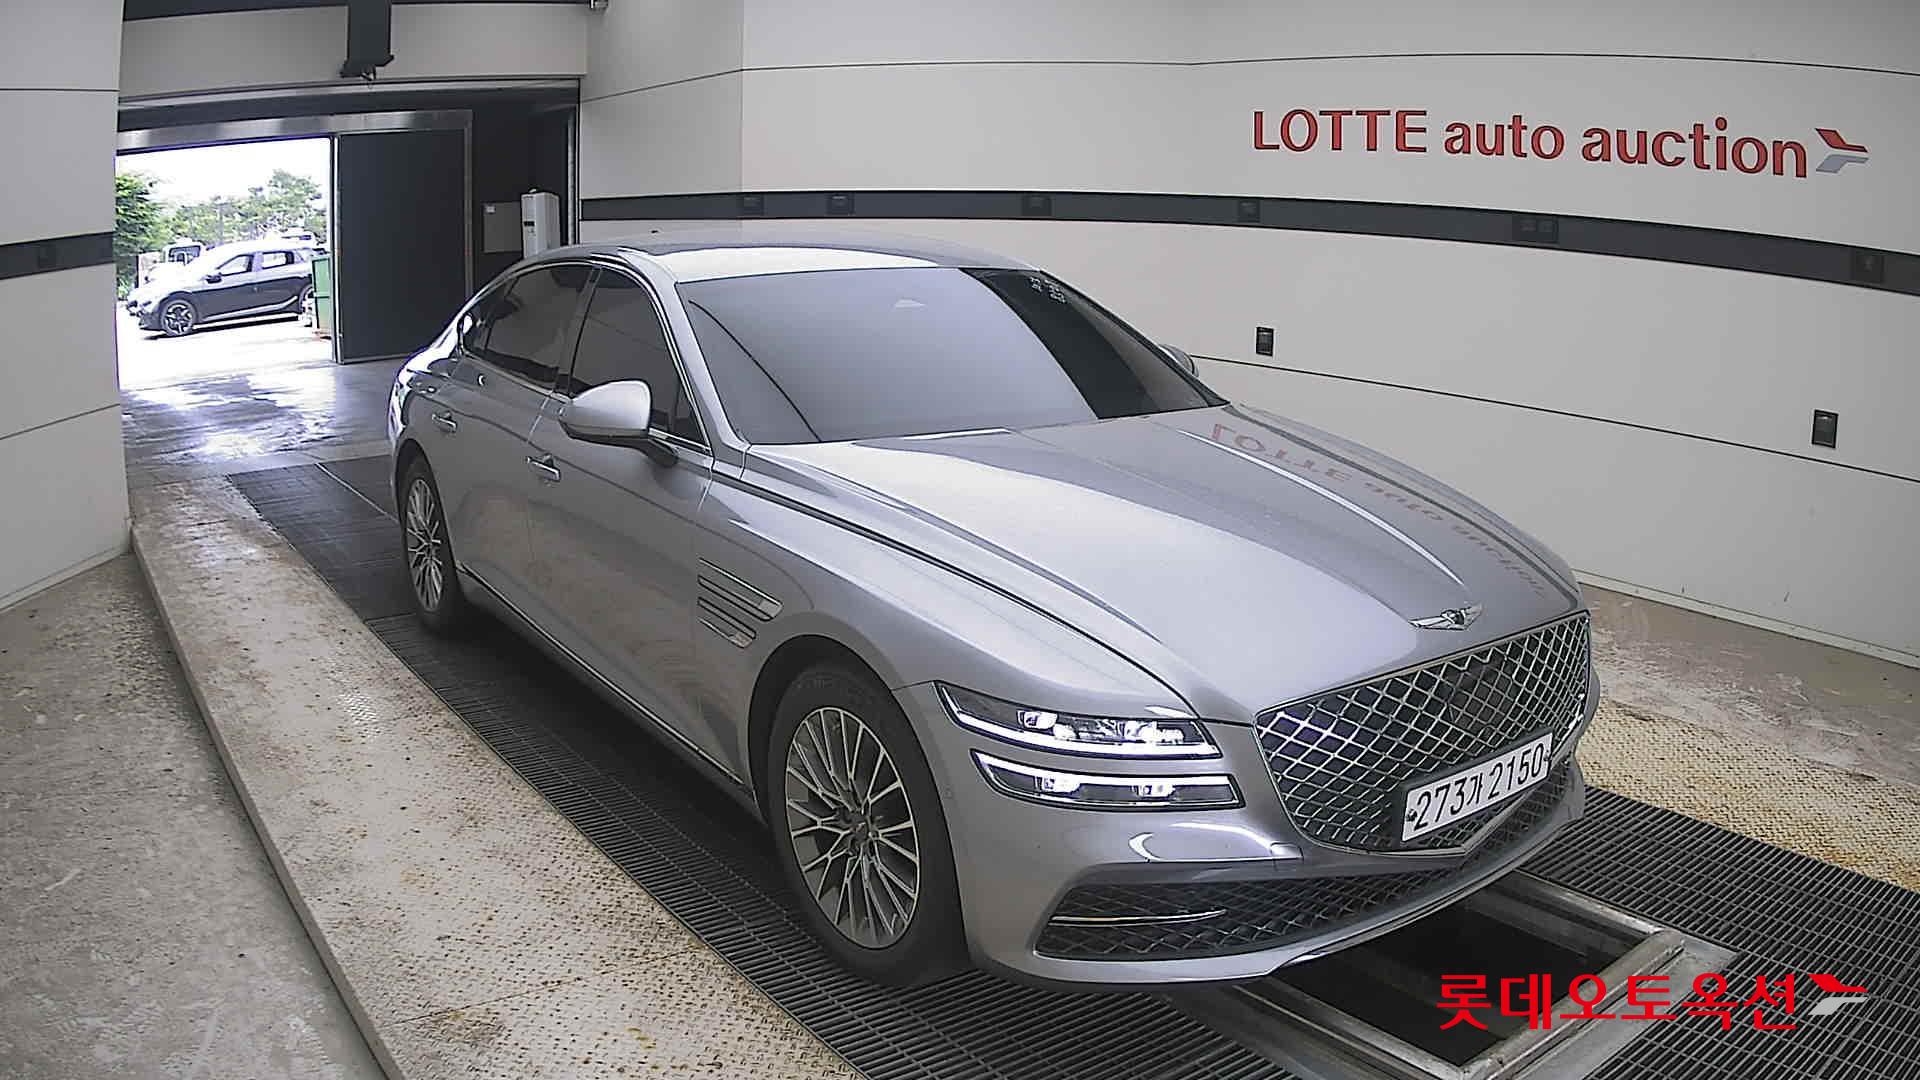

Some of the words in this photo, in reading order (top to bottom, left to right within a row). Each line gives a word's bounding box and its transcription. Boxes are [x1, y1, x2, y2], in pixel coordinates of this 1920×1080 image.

[1253, 109, 1427, 153] LOTTE
[1443, 114, 1566, 160] auto
[1582, 116, 1808, 178] auction
[1414, 772, 1484, 832] 273가
[1487, 742, 1545, 801] 2150
